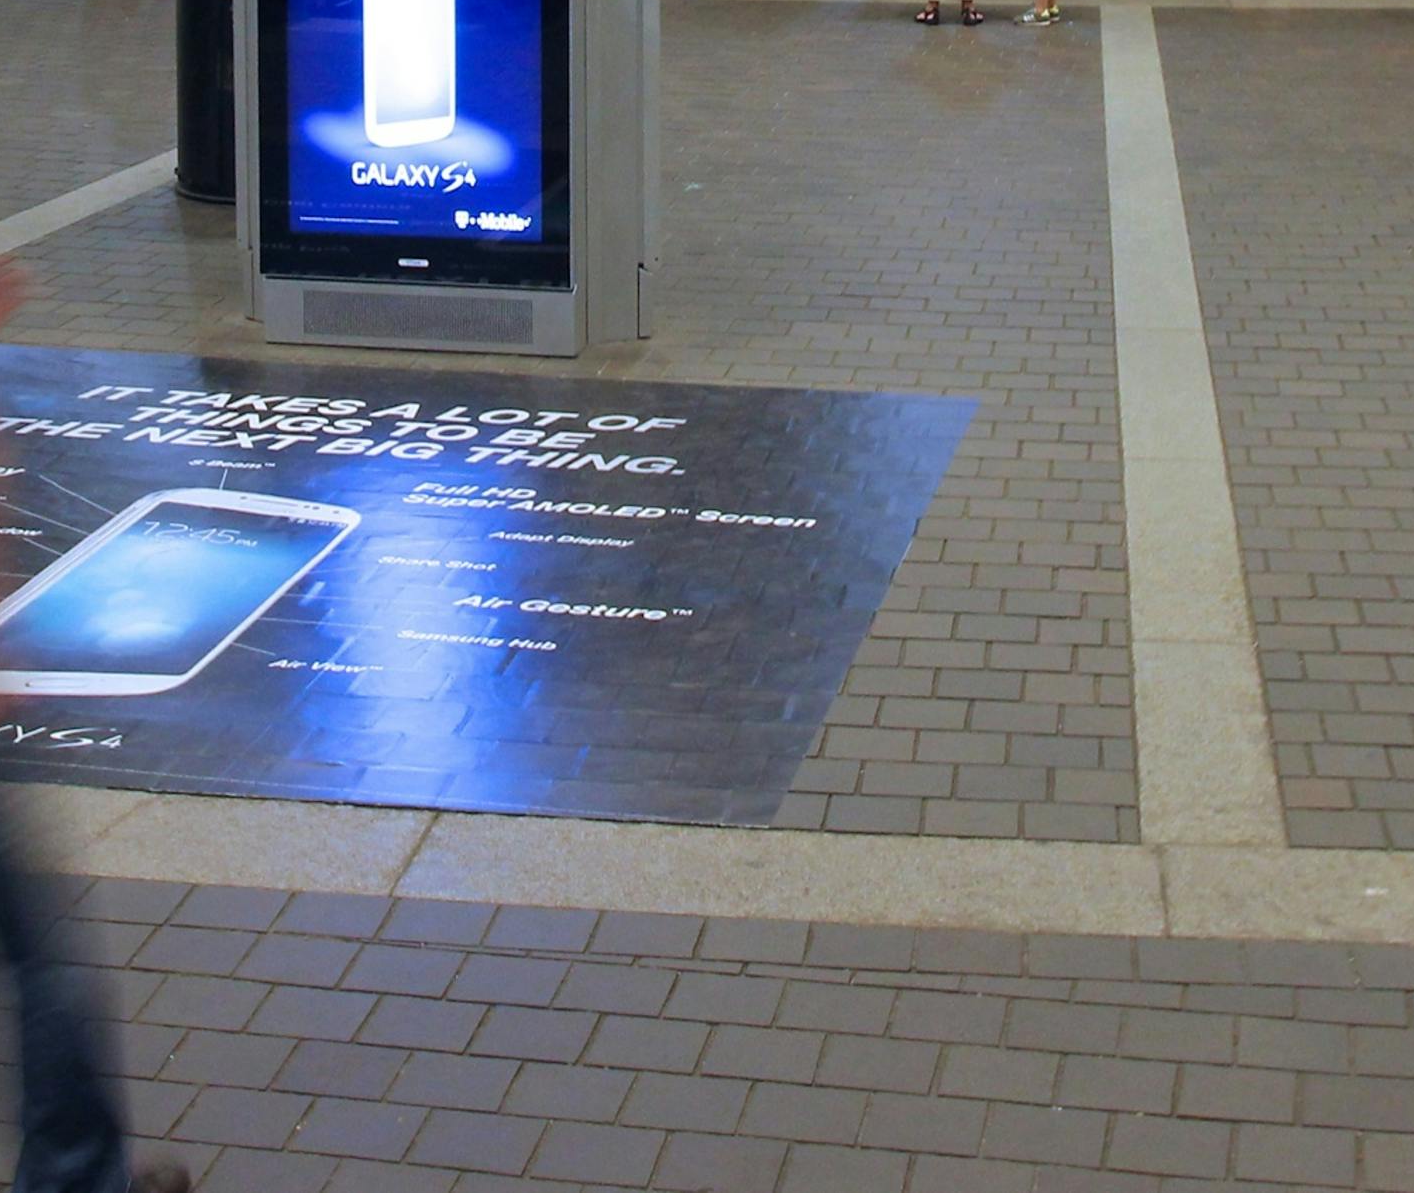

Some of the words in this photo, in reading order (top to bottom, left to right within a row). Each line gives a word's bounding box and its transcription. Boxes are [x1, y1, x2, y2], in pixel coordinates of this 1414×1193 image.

[352, 161, 439, 188] GALAXY
[78, 385, 154, 400] IT
[159, 389, 367, 417] TAKES
[369, 403, 420, 419] A
[435, 406, 579, 428] LOT
[587, 414, 687, 433] OF
[128, 406, 372, 436] THINGS
[390, 421, 479, 442] TO
[489, 427, 597, 449] BE
[122, 426, 318, 452] NEXT
[316, 437, 445, 460] BIG
[464, 445, 686, 475] THING.
[412, 482, 473, 495] Full
[481, 486, 537, 500] HD
[402, 493, 506, 511] Super
[695, 510, 818, 529] Screen
[144, 521, 241, 545] 12:45
[489, 531, 555, 545] Adapt
[557, 535, 636, 550] Display
[378, 556, 441, 568] Share
[444, 558, 497, 572] Shot
[452, 594, 514, 610] Air
[396, 629, 506, 648] Samsung
[507, 637, 557, 651] Hub
[268, 658, 306, 669] Air
